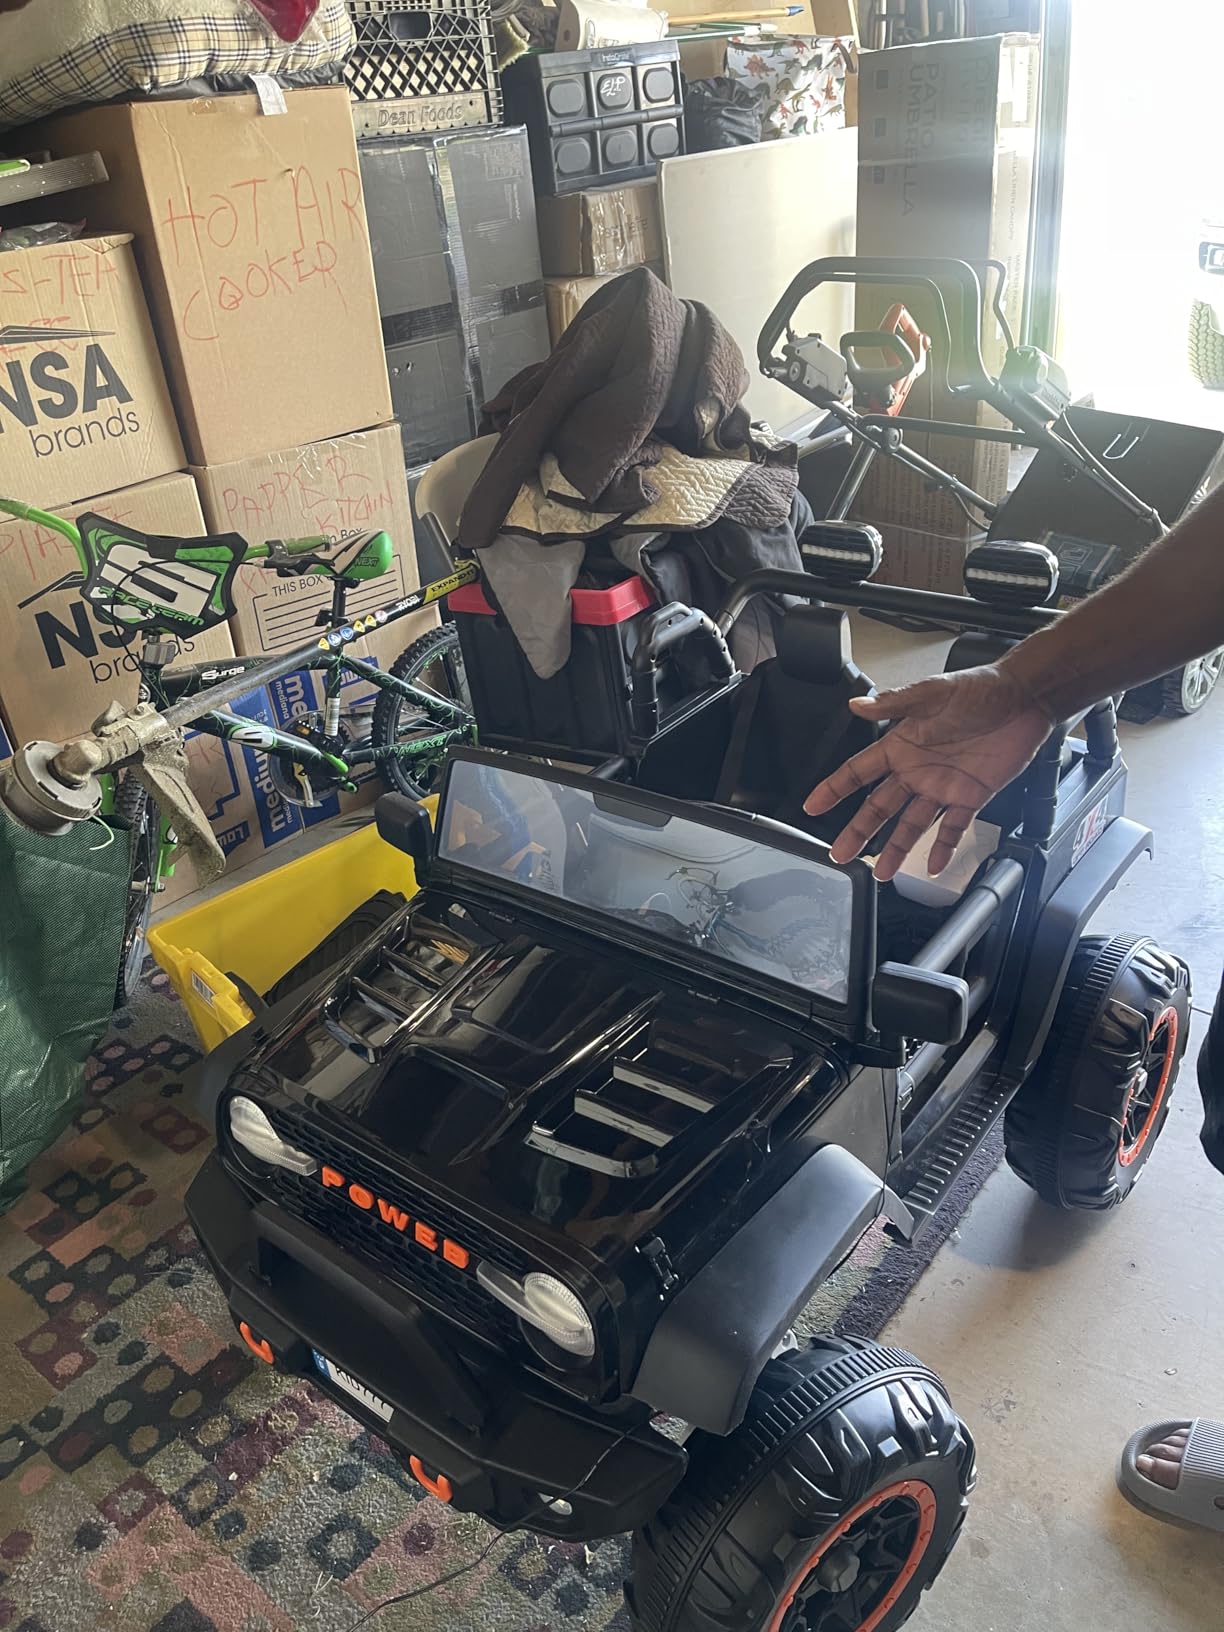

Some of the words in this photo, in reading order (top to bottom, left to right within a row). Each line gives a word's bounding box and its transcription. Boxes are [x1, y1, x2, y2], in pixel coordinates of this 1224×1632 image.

[377, 108, 416, 128] Dean
[420, 102, 465, 124] Foods
[902, 63, 922, 217] UMBRELLA
[921, 63, 939, 149] PATIO
[162, 178, 267, 268] HOT
[291, 165, 362, 250] AIR
[183, 240, 346, 341] COOKER
[29, 407, 141, 458] brands
[271, 578, 299, 597] THIS
[299, 573, 324, 590] BOX
[201, 665, 246, 682] Surge
[321, 1165, 470, 1270] POWER
